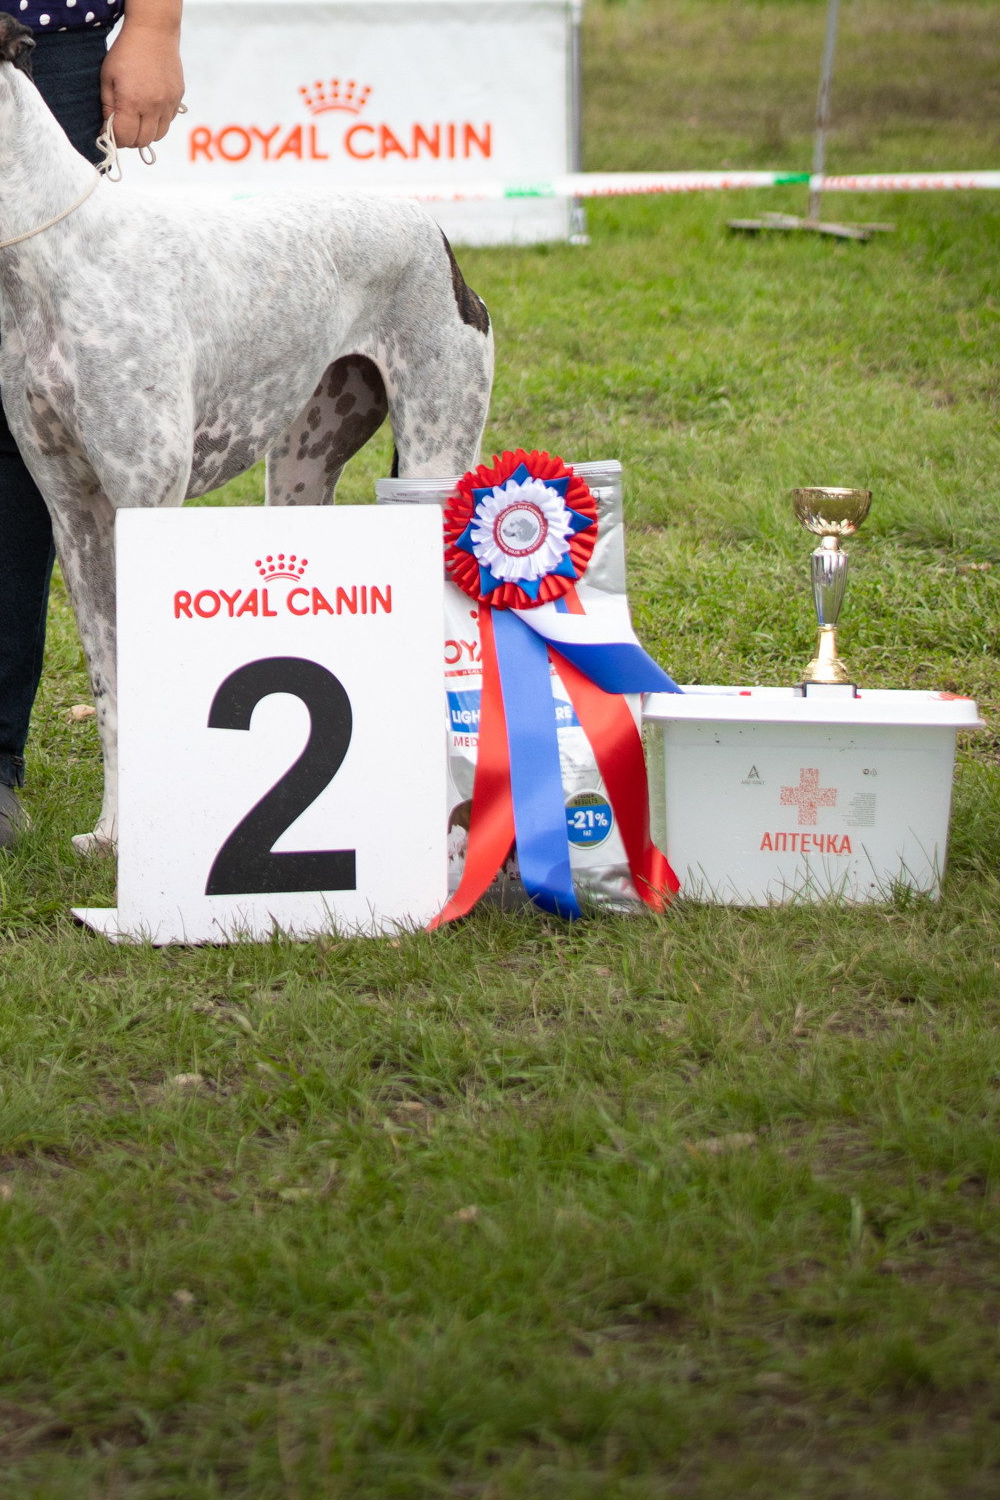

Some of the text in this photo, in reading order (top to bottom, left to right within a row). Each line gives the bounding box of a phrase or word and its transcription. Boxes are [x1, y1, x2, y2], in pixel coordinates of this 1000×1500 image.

[189, 122, 492, 162] ROYAL CANIN
[174, 584, 392, 619] ROYAL CANIN
[205, 657, 356, 895] 2
[567, 810, 609, 829] -21%
[760, 831, 852, 854] АПТЕЧКА
